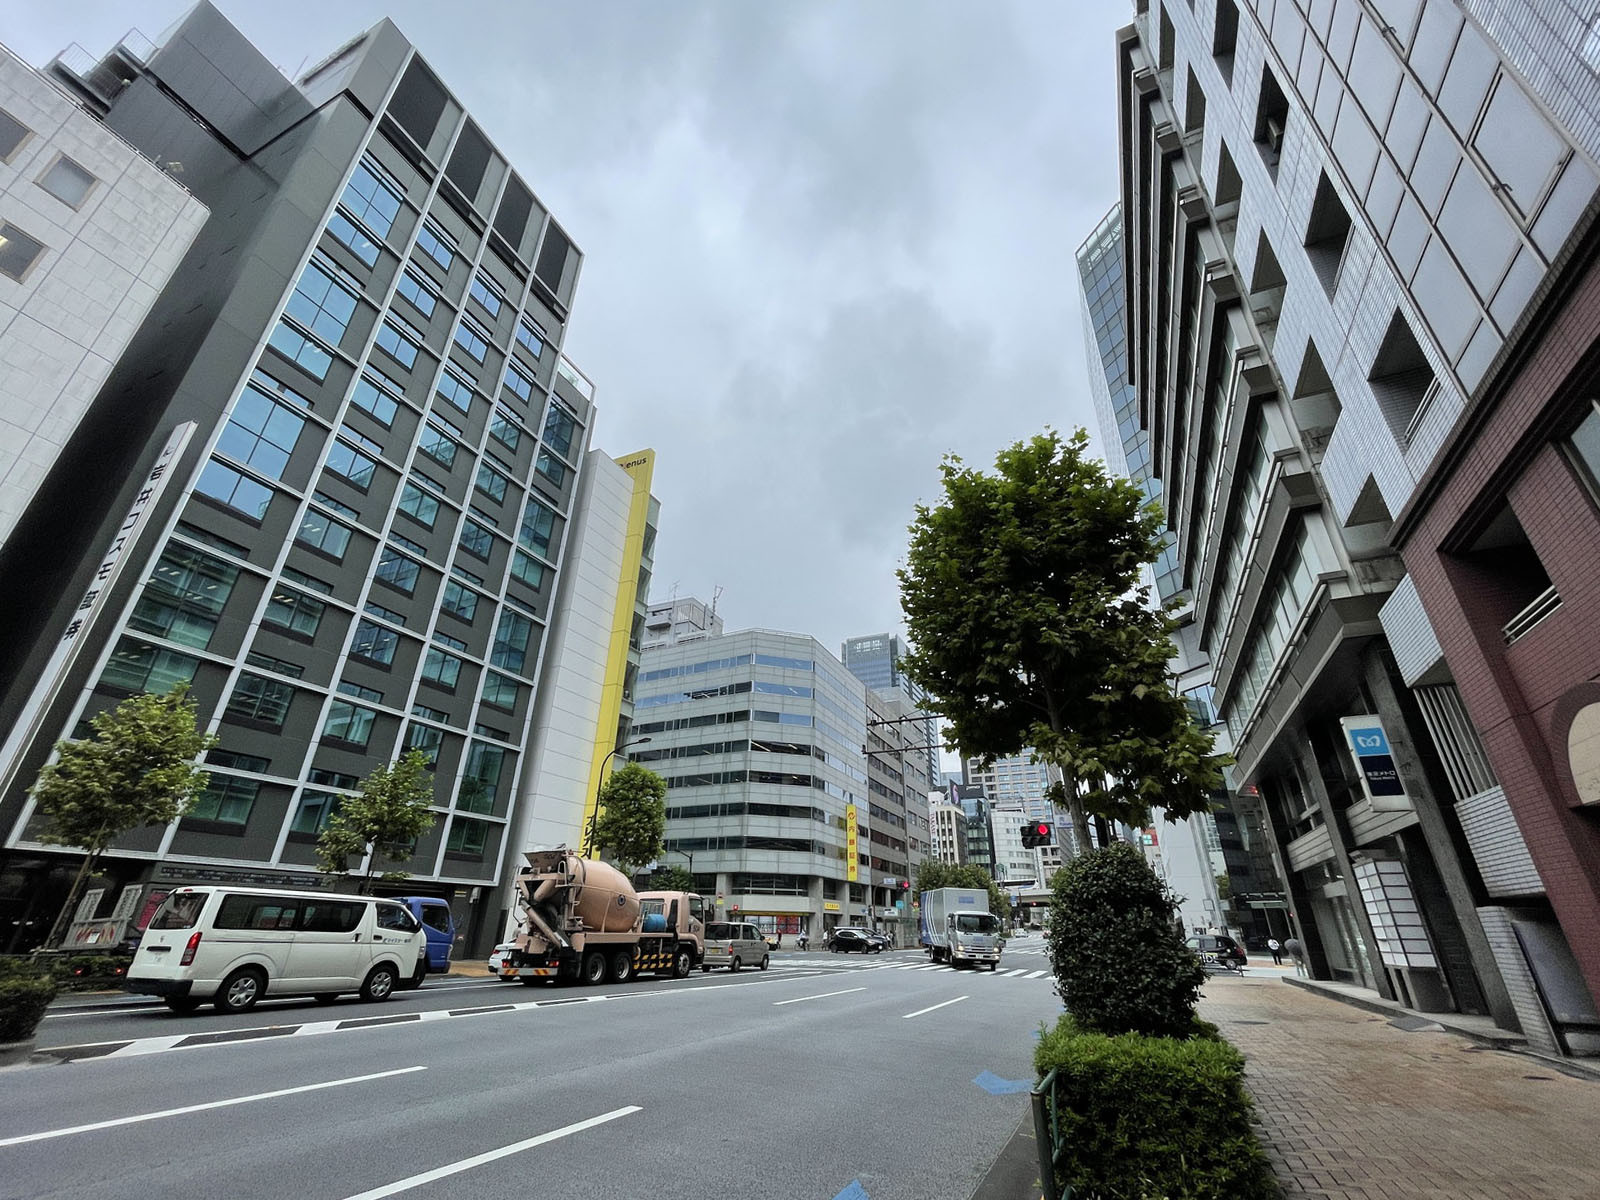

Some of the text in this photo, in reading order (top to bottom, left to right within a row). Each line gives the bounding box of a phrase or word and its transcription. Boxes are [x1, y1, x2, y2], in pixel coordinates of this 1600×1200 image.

[64, 463, 166, 641] 岩井コスモ証券
